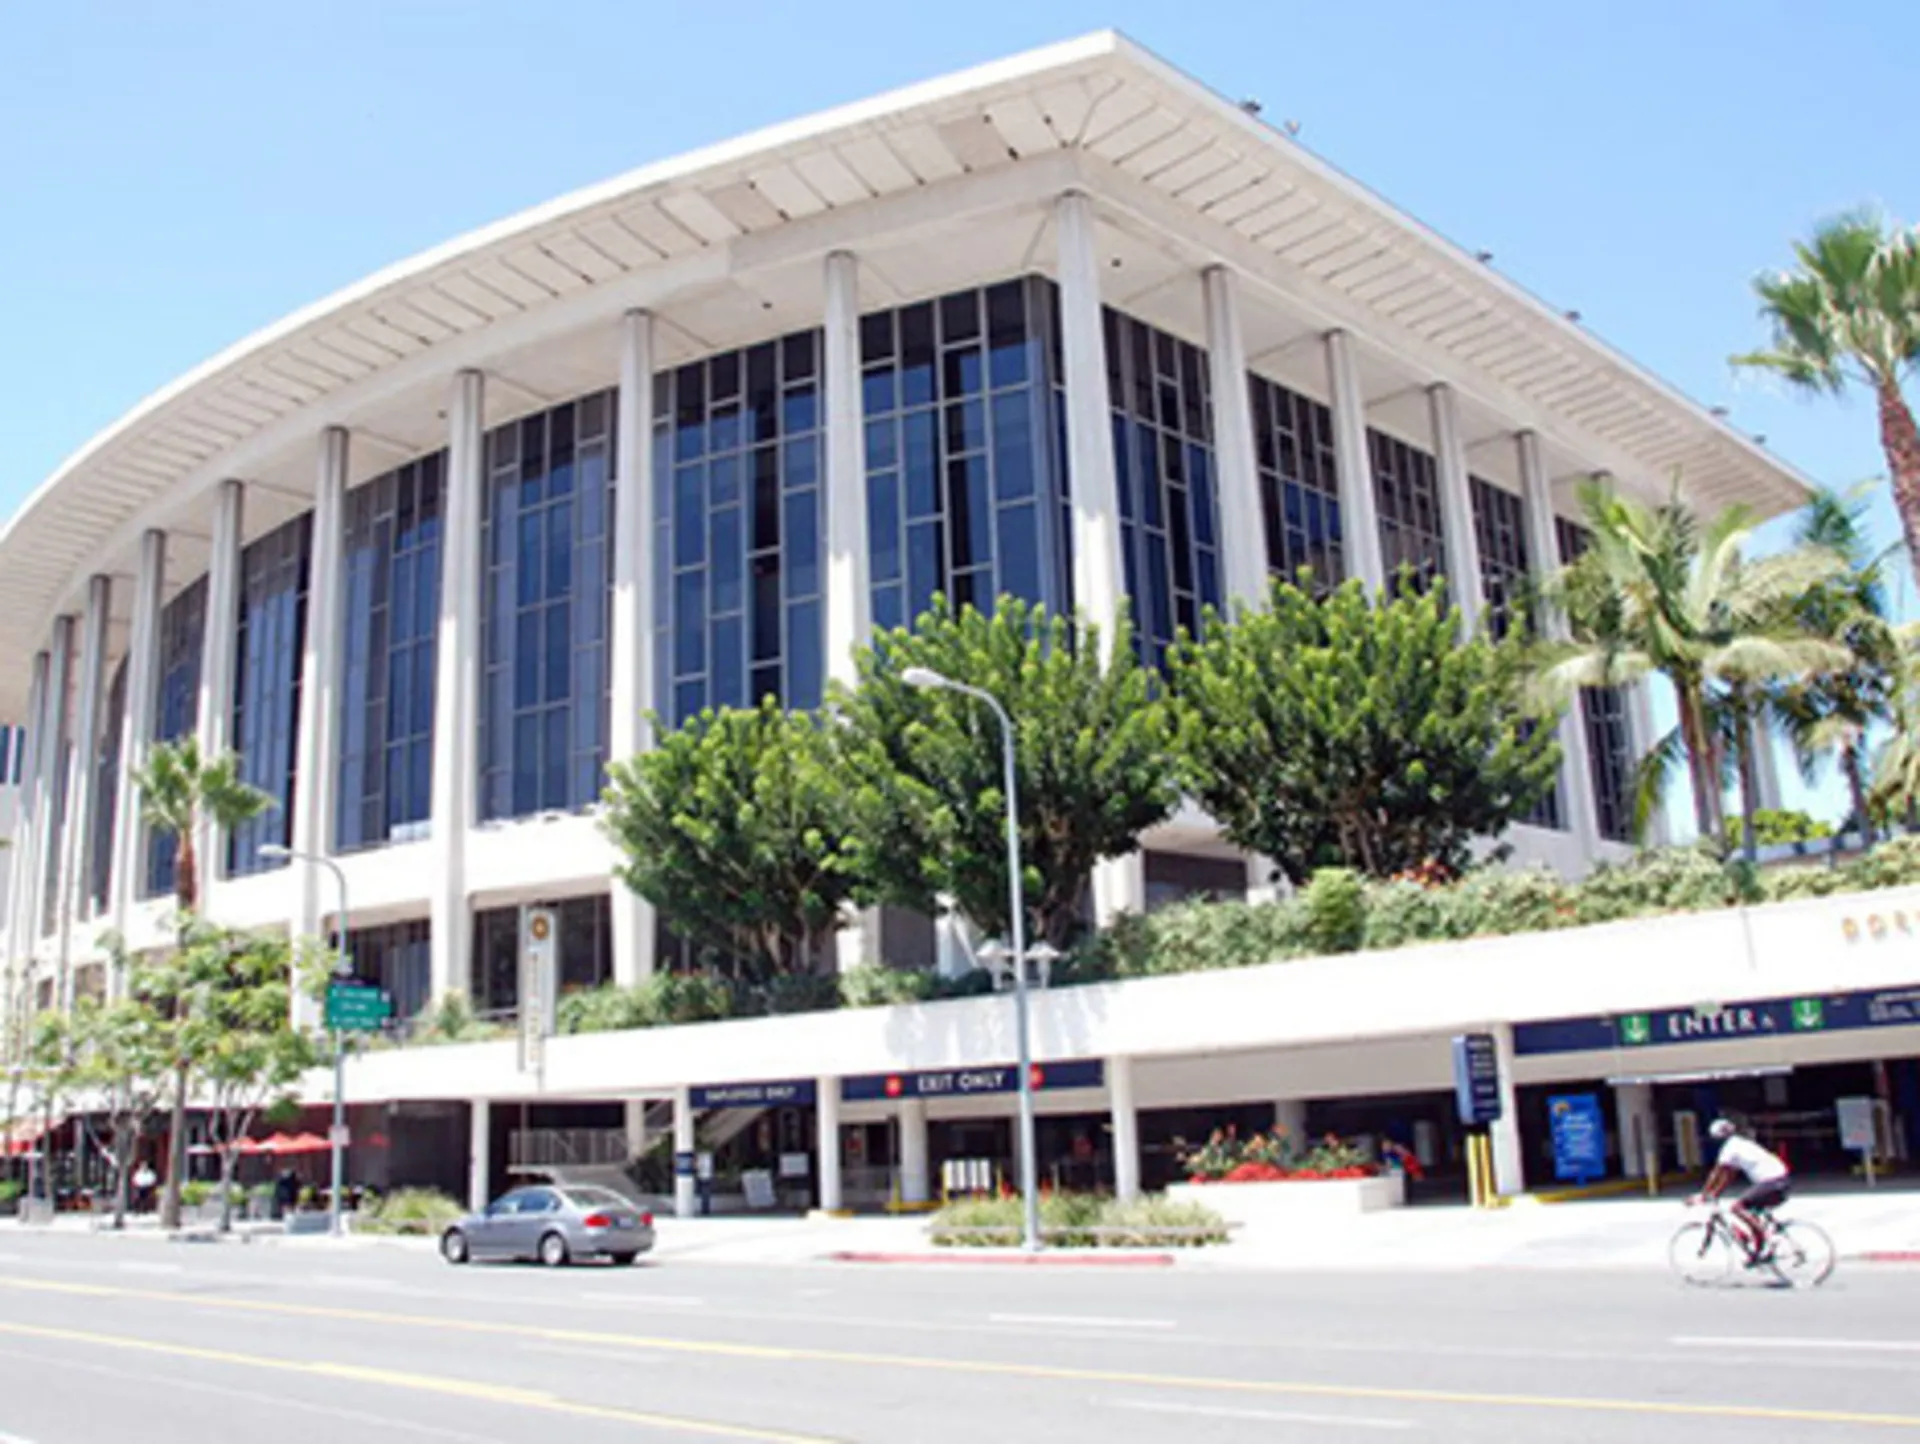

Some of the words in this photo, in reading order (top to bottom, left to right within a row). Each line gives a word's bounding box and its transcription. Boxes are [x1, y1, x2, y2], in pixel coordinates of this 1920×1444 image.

[1841, 909, 1920, 942] DOR
[1667, 1008, 1757, 1037] ENTER
[917, 1073, 953, 1092] EXIT
[958, 1070, 1004, 1090] ONLY
